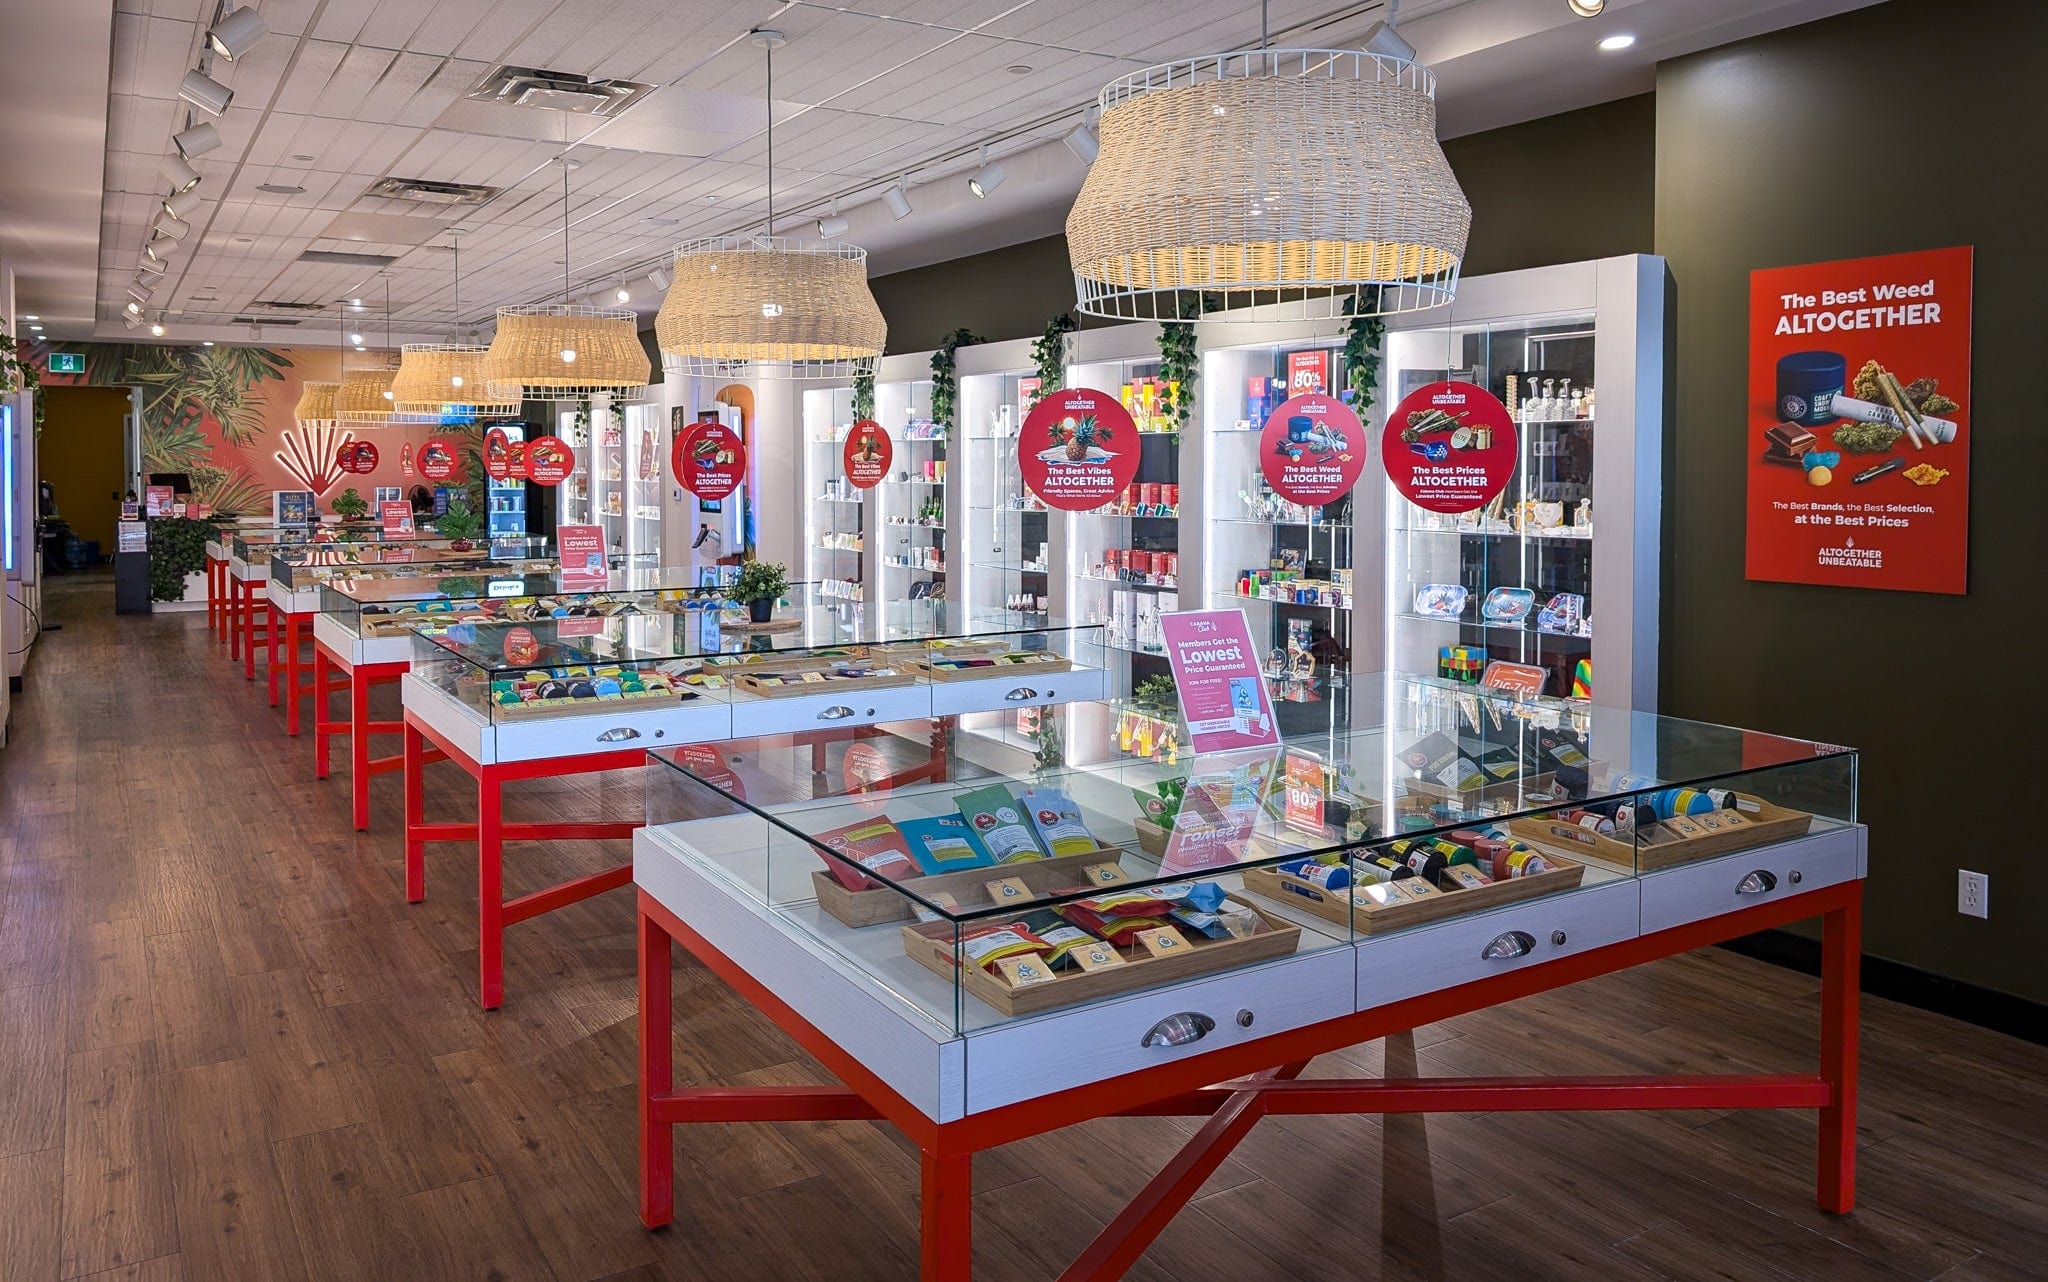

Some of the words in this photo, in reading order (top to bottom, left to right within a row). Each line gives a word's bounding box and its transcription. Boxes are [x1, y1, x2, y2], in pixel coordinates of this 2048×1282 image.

[1781, 293, 1816, 309] The
[1822, 288, 1866, 306] Best
[1872, 280, 1934, 301] Weed
[1774, 302, 1941, 336] ALTOGETHER
[1456, 467, 1485, 475] Prices
[1044, 477, 1114, 486] ALTOGETHER
[1282, 475, 1343, 483] ALTOGETHER
[1411, 477, 1488, 486] ALTOGETHER
[1773, 502, 1788, 510] The
[1790, 502, 1809, 510] Best
[1811, 502, 1845, 512] Brands,
[1847, 504, 1862, 512] the
[1864, 504, 1884, 512] Best
[1886, 504, 1935, 514] Selection,
[1795, 515, 1808, 524] at
[1811, 514, 1832, 525] the
[1835, 515, 1864, 526] Best
[1868, 516, 1909, 528] Prices
[1819, 548, 1882, 559] ALTOGETHER
[1819, 557, 1882, 568] UNBEATABLE
[1178, 640, 1212, 649] Members
[1213, 638, 1225, 646] Get
[1226, 637, 1239, 645] the
[1180, 646, 1243, 664] Lowest
[1185, 665, 1204, 674] Price
[1205, 662, 1246, 673] Guaranteed
